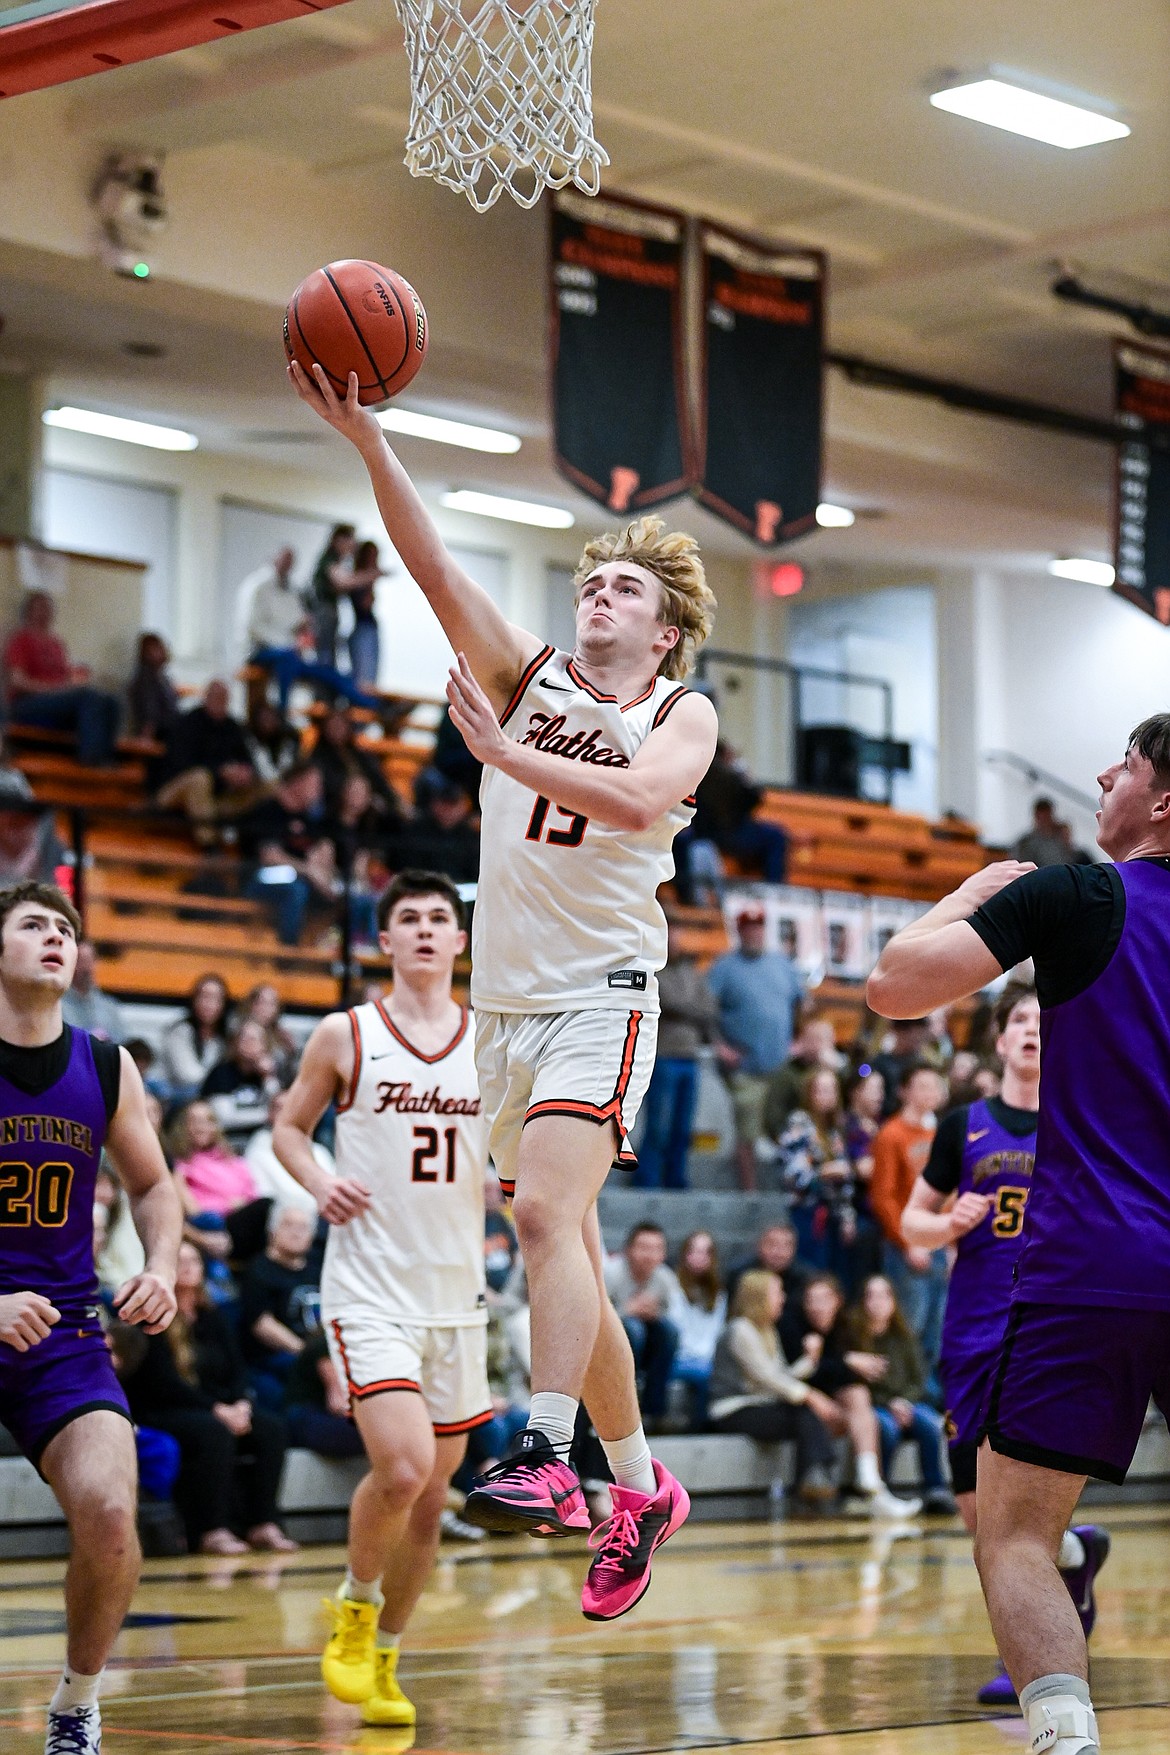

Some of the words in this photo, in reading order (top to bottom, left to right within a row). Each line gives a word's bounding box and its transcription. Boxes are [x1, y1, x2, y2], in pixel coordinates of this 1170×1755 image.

[376, 289, 396, 317] NFHS
[411, 1126, 457, 1182] 21
[0, 1161, 75, 1227] 20
[992, 1185, 1030, 1238] 5
